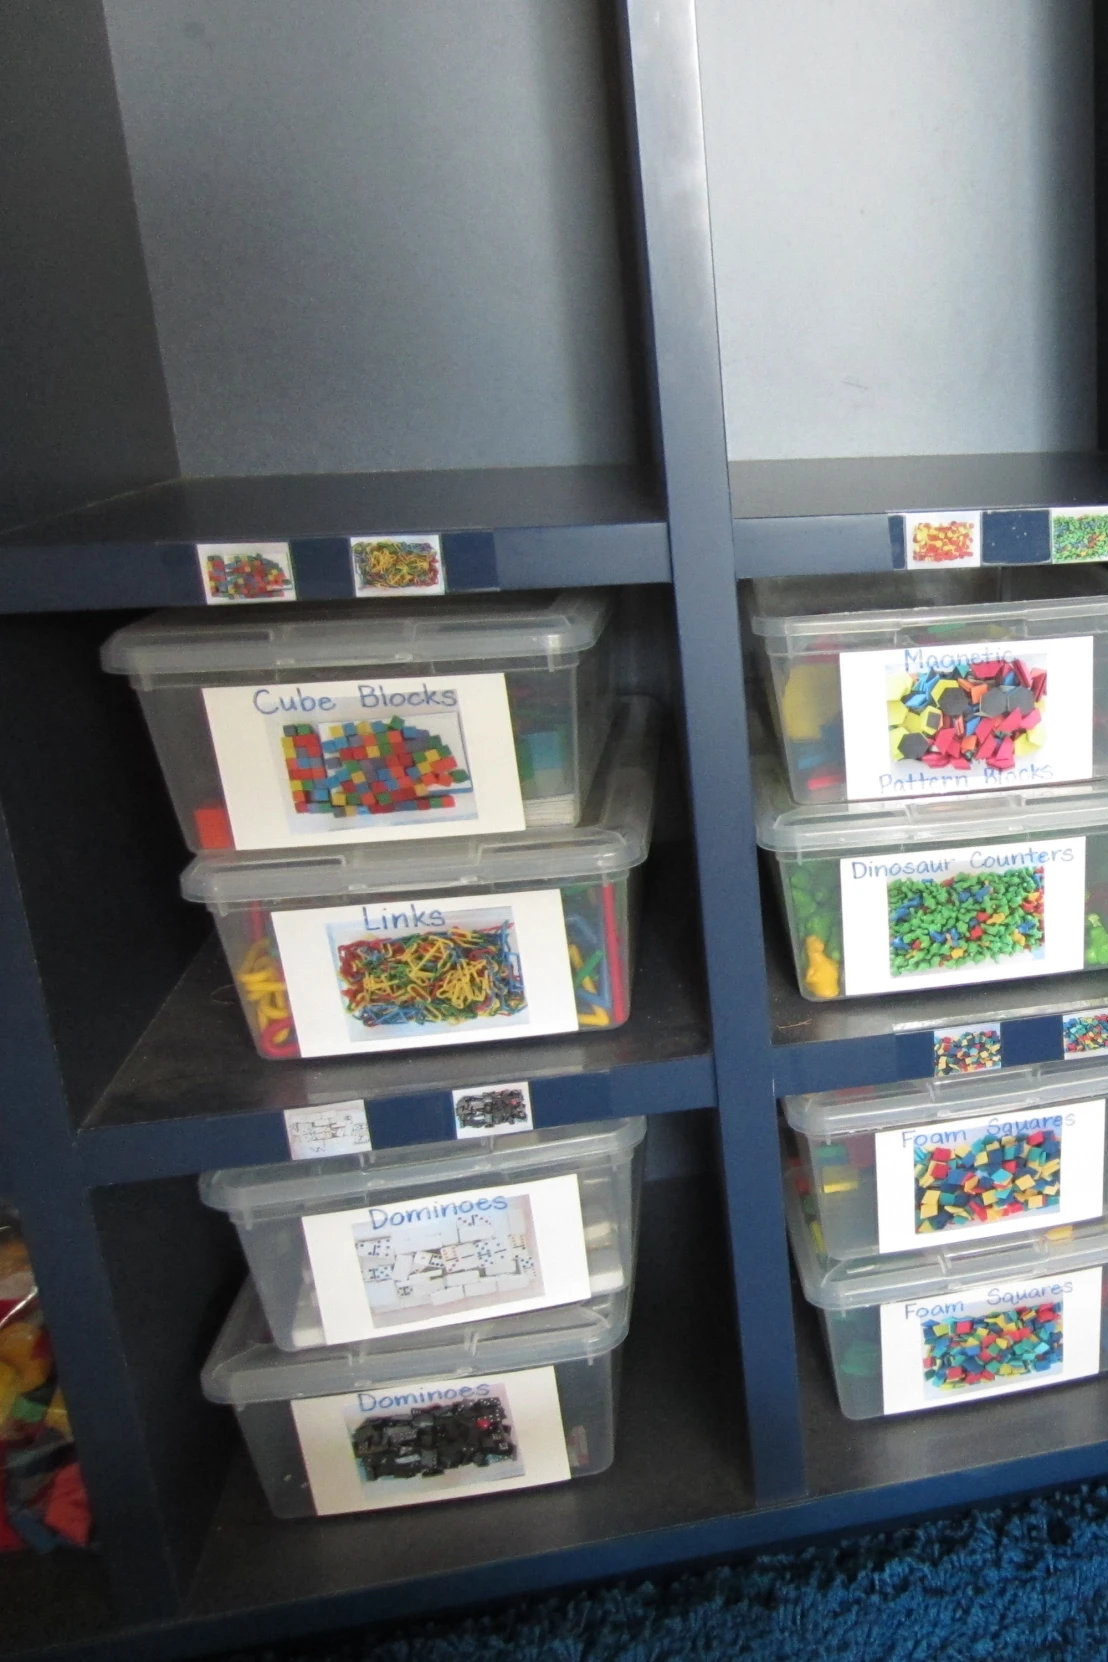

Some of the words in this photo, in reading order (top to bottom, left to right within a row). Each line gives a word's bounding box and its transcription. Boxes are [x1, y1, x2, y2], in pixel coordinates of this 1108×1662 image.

[904, 646, 1015, 676] Magnetic
[254, 687, 337, 717] Cube
[359, 685, 458, 710] Blocks
[879, 771, 968, 795] Pattern
[984, 761, 1054, 786] Blocks
[852, 859, 955, 880] Dinosaur
[970, 848, 1074, 869] Counters
[364, 905, 446, 931] Links
[901, 1128, 967, 1149] Foam
[987, 1113, 1076, 1139] Squares
[368, 1193, 508, 1230] Dominoes
[904, 1299, 964, 1320] Foam
[987, 1281, 1074, 1307] Squares
[358, 1381, 491, 1412] Dominoes
